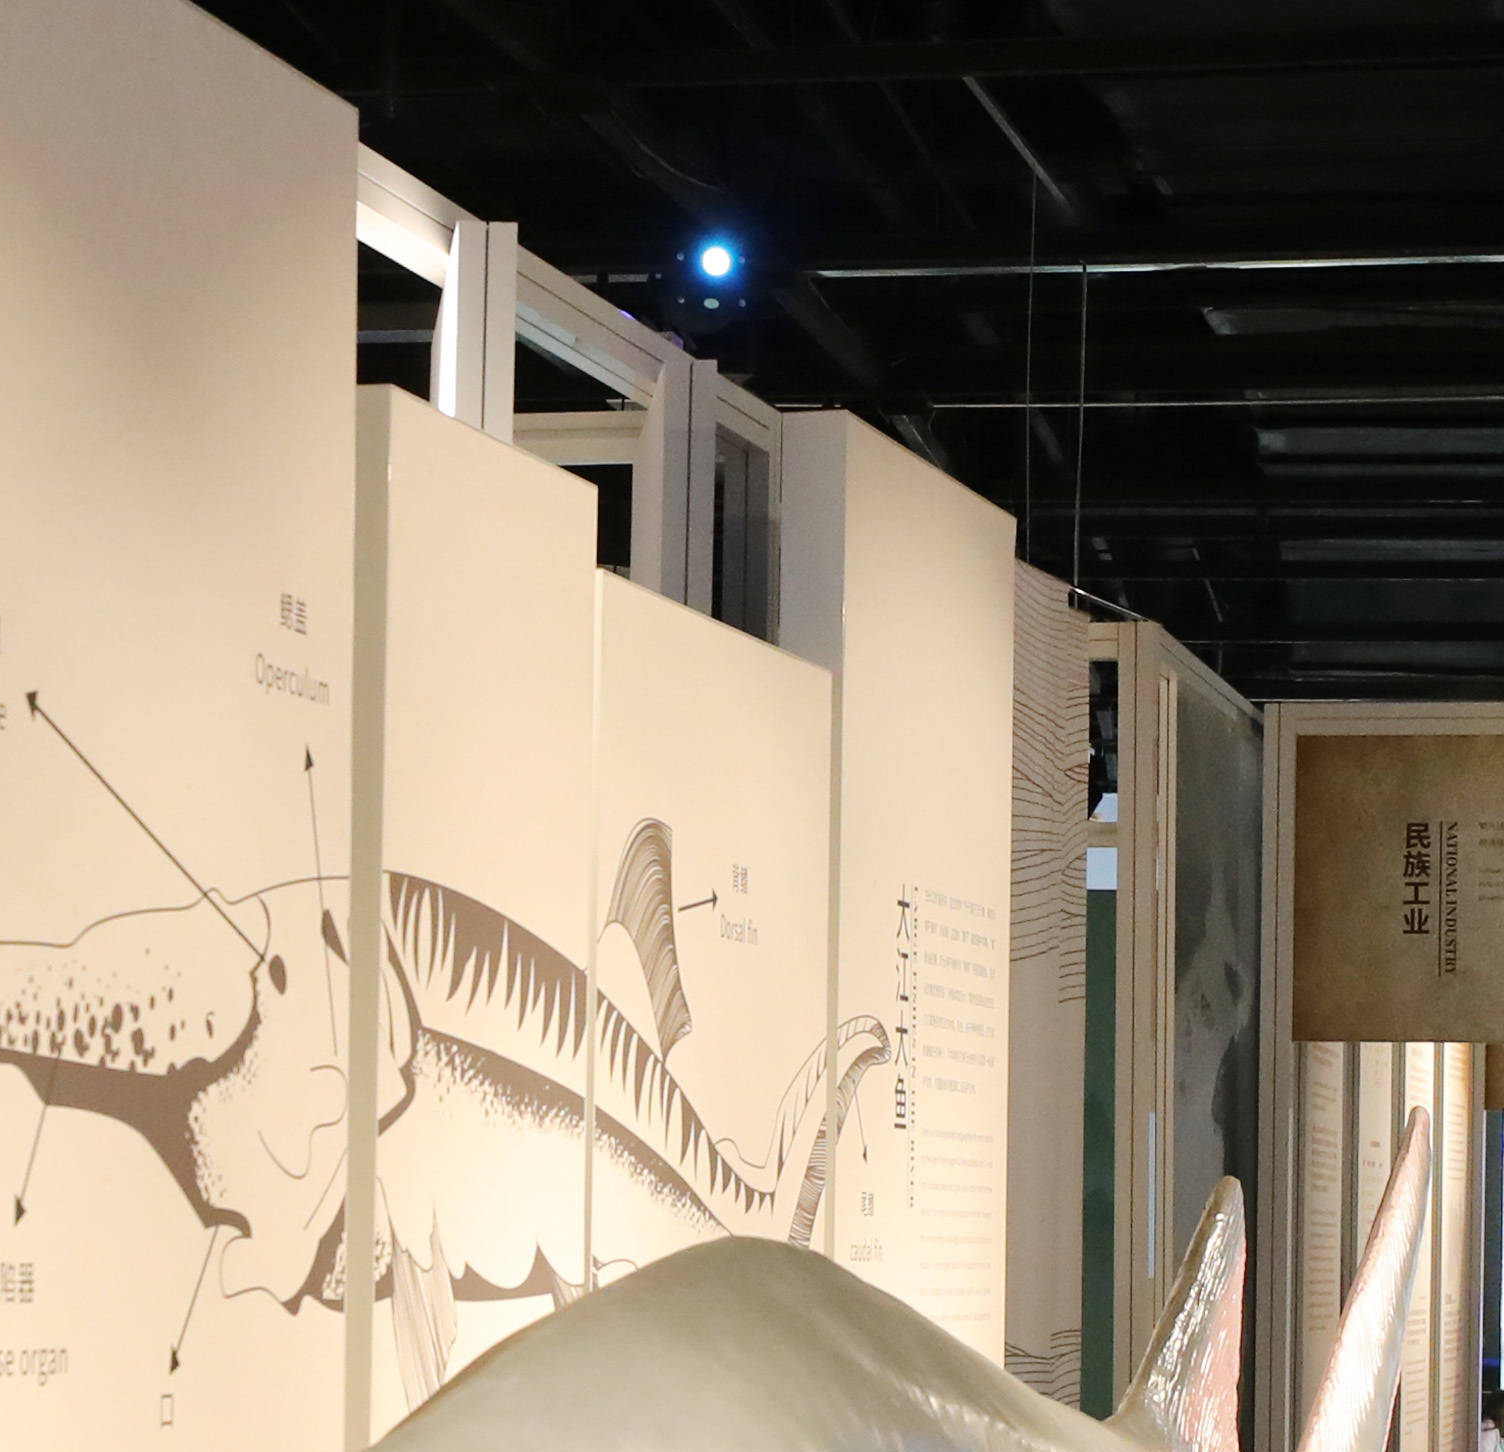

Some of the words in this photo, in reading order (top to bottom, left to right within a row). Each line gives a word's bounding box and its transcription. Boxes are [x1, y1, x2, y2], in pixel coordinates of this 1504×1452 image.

[255, 652, 330, 706] Operculum
[1402, 822, 1431, 935] 民族工业
[1445, 821, 1458, 897] NATIONAL
[1444, 900, 1458, 977] INDUSTRY
[894, 883, 911, 1130] 大江大鱼
[21, 1347, 69, 1387] organ
